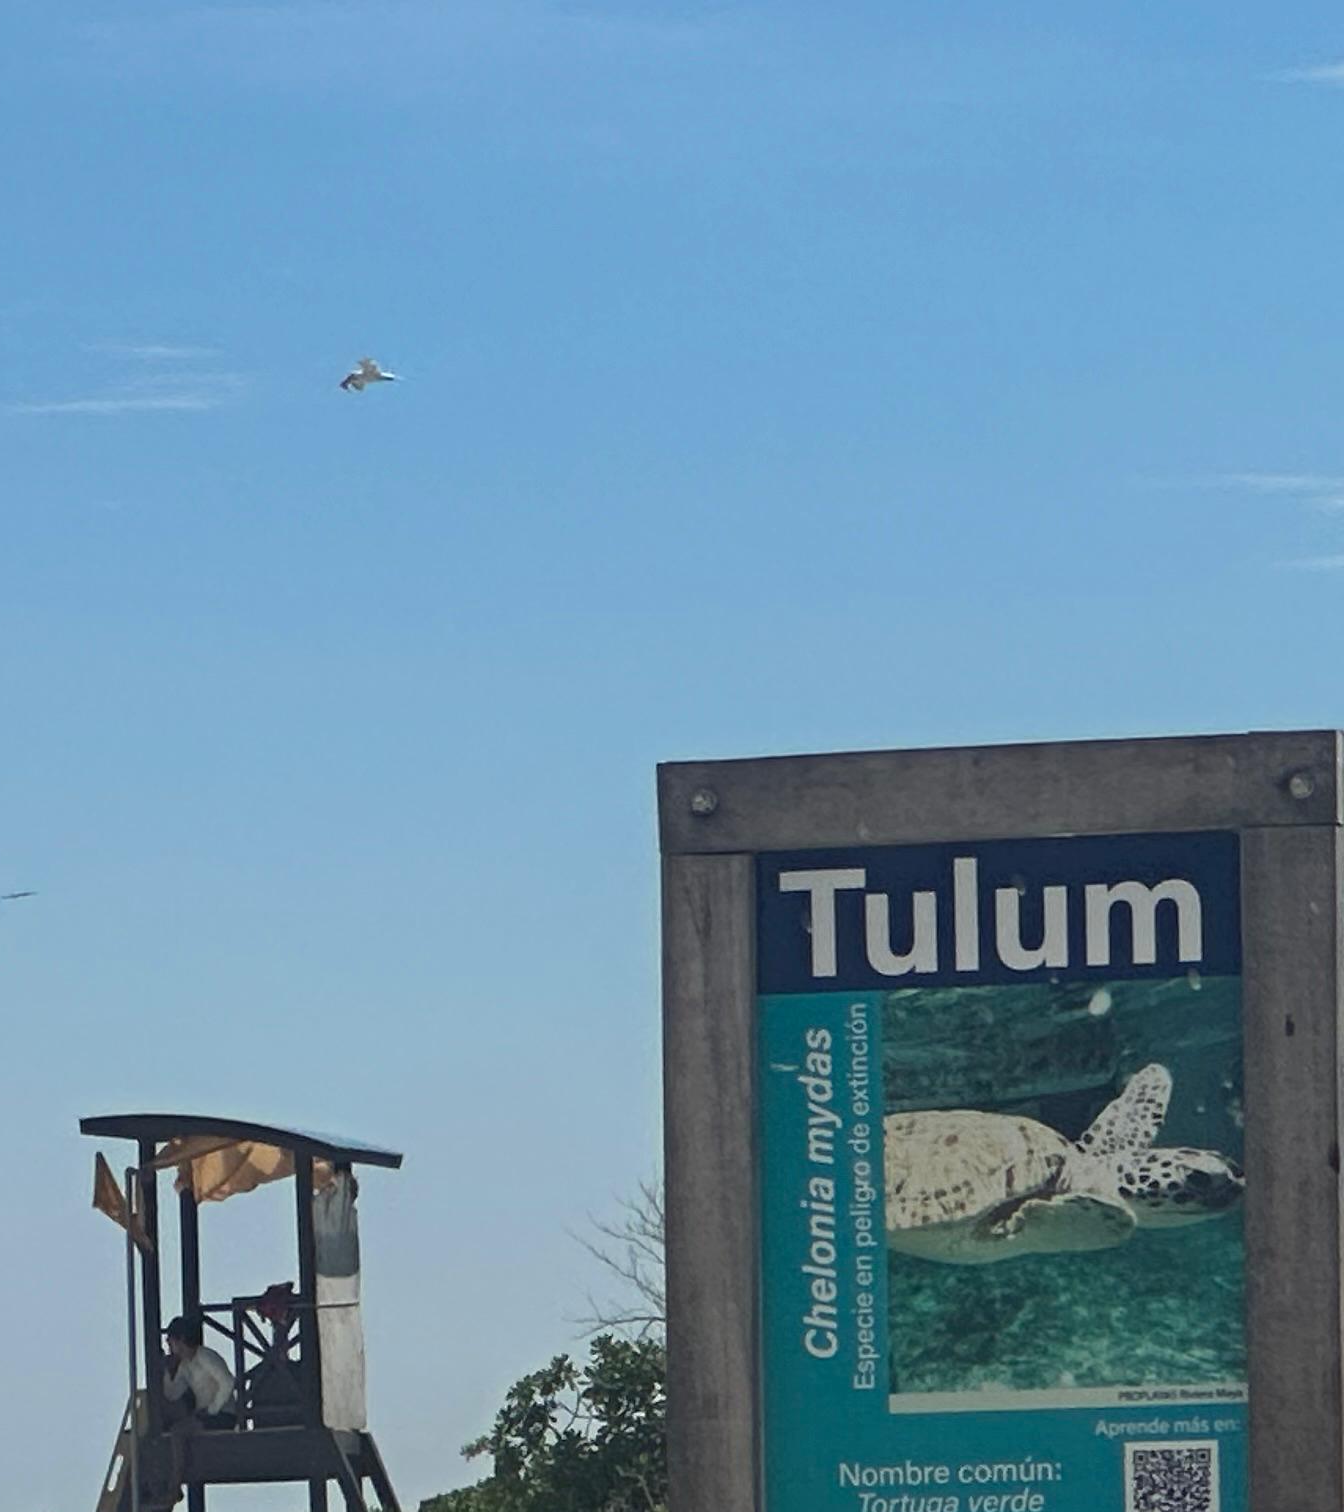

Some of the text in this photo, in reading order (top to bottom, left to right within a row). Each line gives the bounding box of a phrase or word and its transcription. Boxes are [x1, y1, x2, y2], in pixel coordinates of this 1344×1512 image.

[778, 857, 1204, 978] Tulum
[797, 1027, 843, 1359] Chelonia mydas
[845, 1002, 881, 1389] Especie en peligro de extinción
[838, 1455, 1062, 1487] Nombre común:
[1095, 1415, 1241, 1440] Aprende más en:
